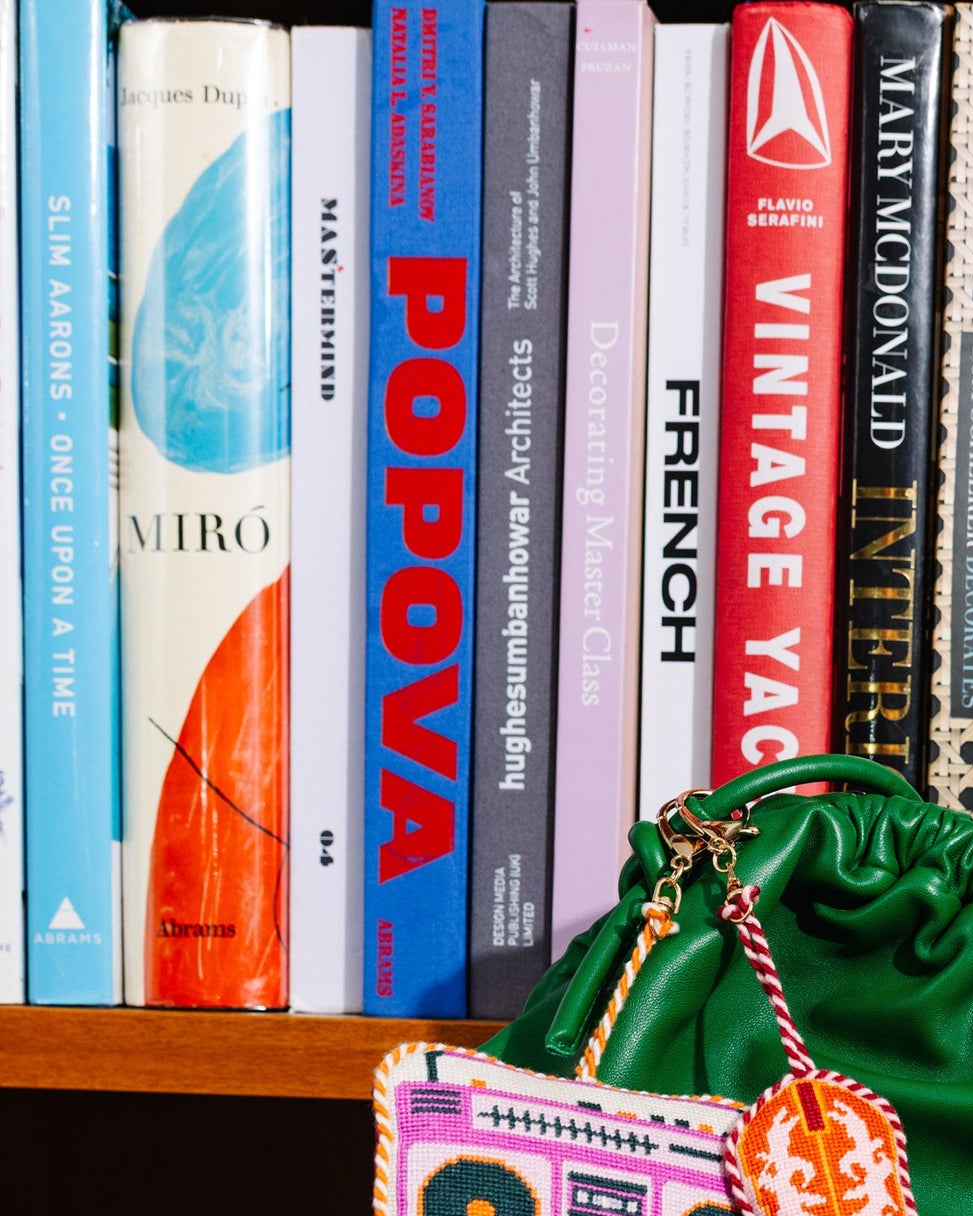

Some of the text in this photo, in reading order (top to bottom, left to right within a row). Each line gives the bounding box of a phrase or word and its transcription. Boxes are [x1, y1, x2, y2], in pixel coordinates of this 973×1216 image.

[391, 7, 407, 87] NATALIA
[421, 8, 437, 80] DMITRI
[120, 85, 272, 109] Jacques Dup
[389, 112, 406, 208] ADASKINA
[418, 103, 437, 223] SARABIANOV
[524, 79, 542, 310] Scott Hughes and John Umbanhowar
[747, 213, 823, 228] SERAFINI
[758, 198, 813, 212] FLAVIO
[508, 191, 522, 310] The Architecture of
[321, 198, 338, 402] MASTERMIND
[48, 195, 76, 717] SLIM AARONS ONCE UPON A TIME
[845, 56, 918, 770] MARY MCDONALD INTERI
[127, 505, 271, 554] MIRÓ
[577, 321, 619, 706] Decorating Master Class
[660, 380, 700, 662] FRENCH
[741, 273, 812, 766] VINTAGE YAC
[378, 256, 468, 885] POPOVA
[499, 339, 534, 790] hughesumbanhowar Architects
[34, 933, 101, 945] ABRAMS
[156, 917, 237, 938] Abrams
[493, 867, 505, 946] DESIGN MEDIA
[508, 879, 521, 946] PUBLISHING
[522, 902, 534, 947] LIMITED
[376, 918, 393, 998] ABRAMS
